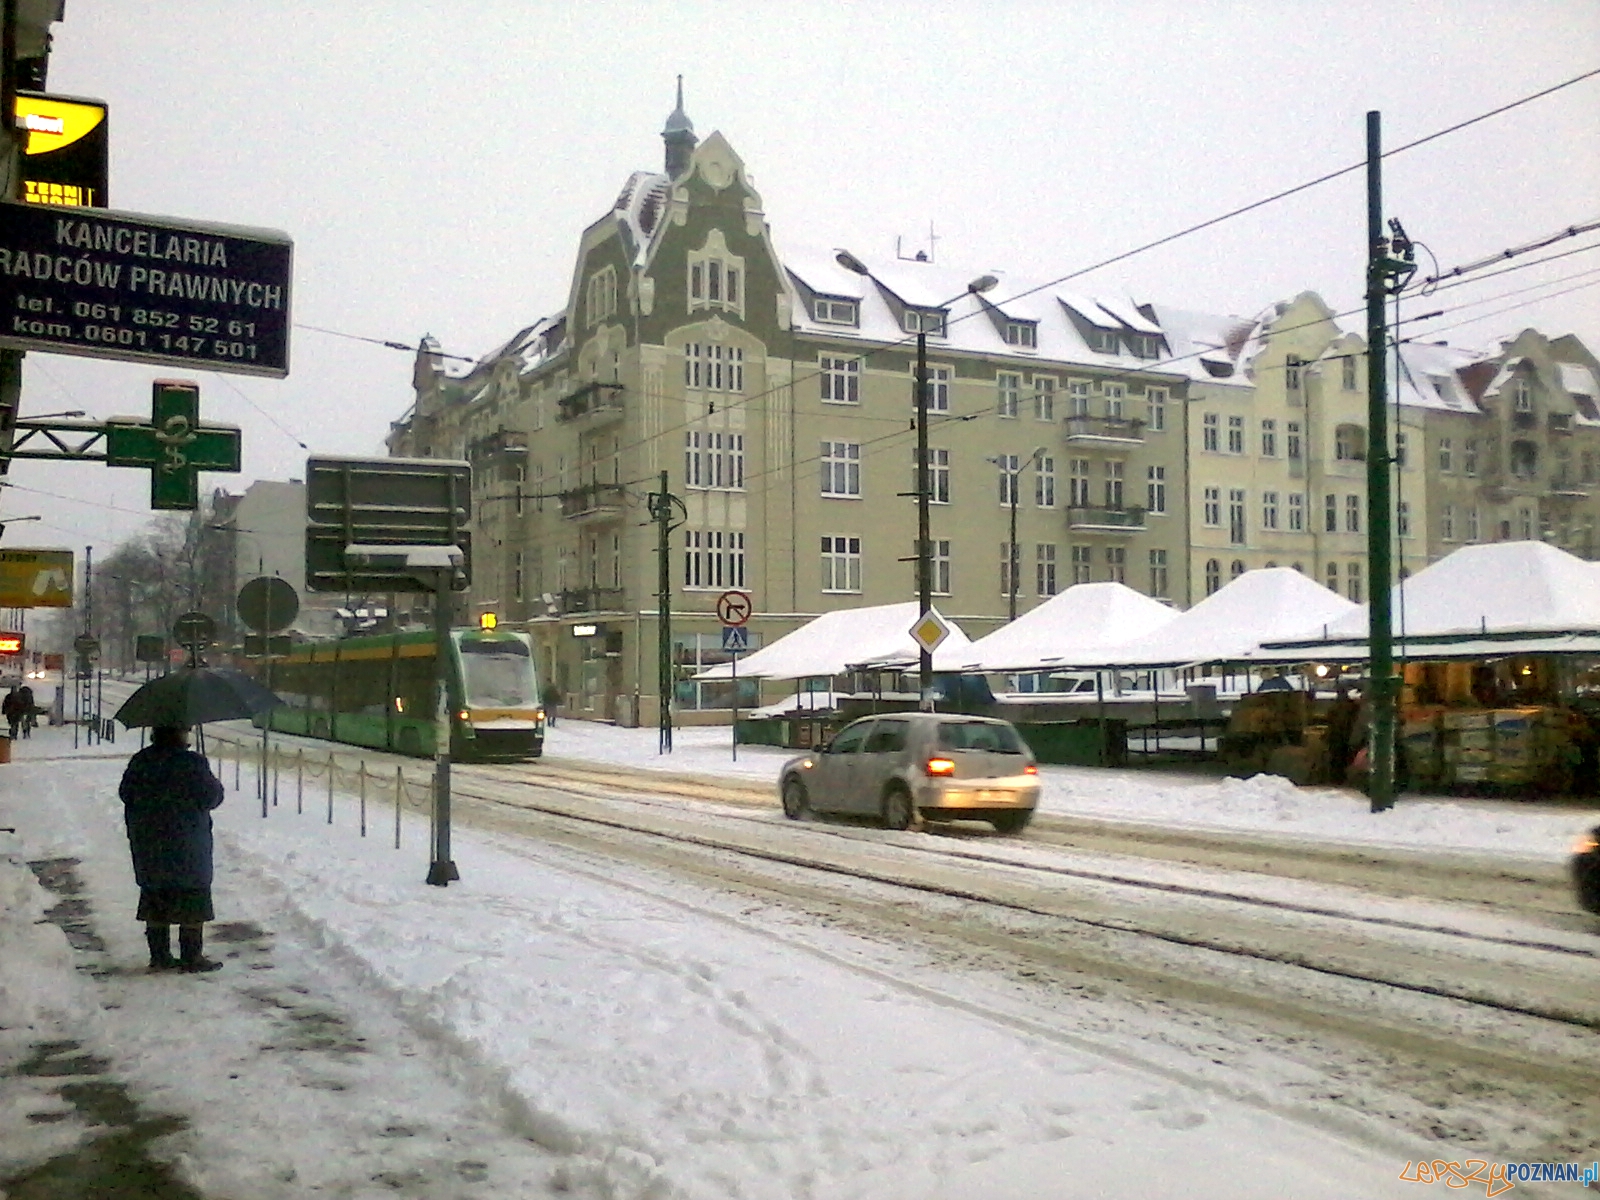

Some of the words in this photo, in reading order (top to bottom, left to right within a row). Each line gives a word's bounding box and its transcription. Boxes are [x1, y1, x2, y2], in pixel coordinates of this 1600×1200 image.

[55, 219, 228, 268] KANCELARIA
[0, 249, 121, 289] RADCÓW
[130, 266, 282, 309] PRAWNYCH
[18, 295, 63, 314] tel.
[75, 301, 121, 322] 061
[132, 308, 180, 329] 852
[189, 315, 219, 336] 52
[228, 321, 256, 338] 61
[160, 333, 207, 353] 147
[215, 341, 256, 360] 501
